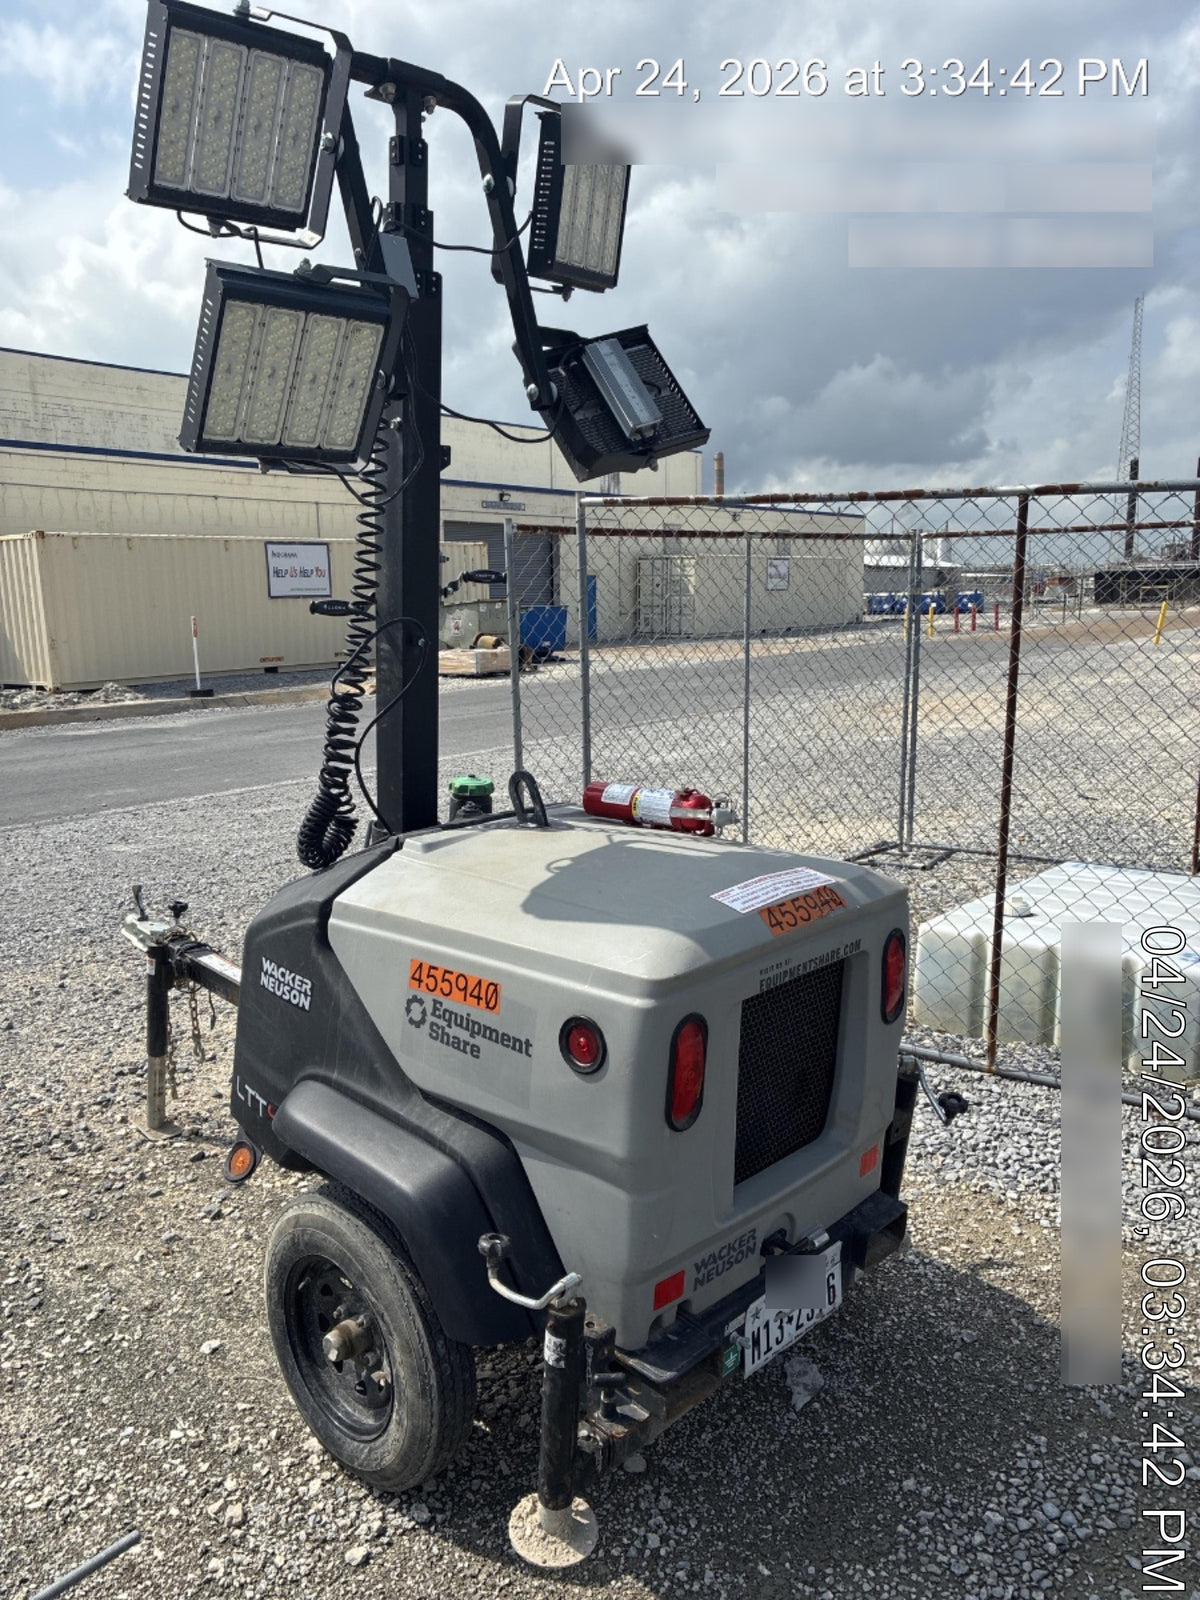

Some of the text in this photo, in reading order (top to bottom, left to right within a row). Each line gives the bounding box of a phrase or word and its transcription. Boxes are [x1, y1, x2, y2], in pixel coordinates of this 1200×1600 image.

[767, 885, 843, 931] 455940
[262, 956, 312, 995] WACKER
[411, 962, 499, 1010] 455940
[759, 938, 862, 992] EQUIPMENTSHARE.COM
[260, 971, 311, 1011] NEUSON
[428, 1021, 481, 1060] Share
[430, 998, 533, 1058] Equipment
[693, 1228, 757, 1275] WACKER
[693, 1240, 757, 1292] NEUSON
